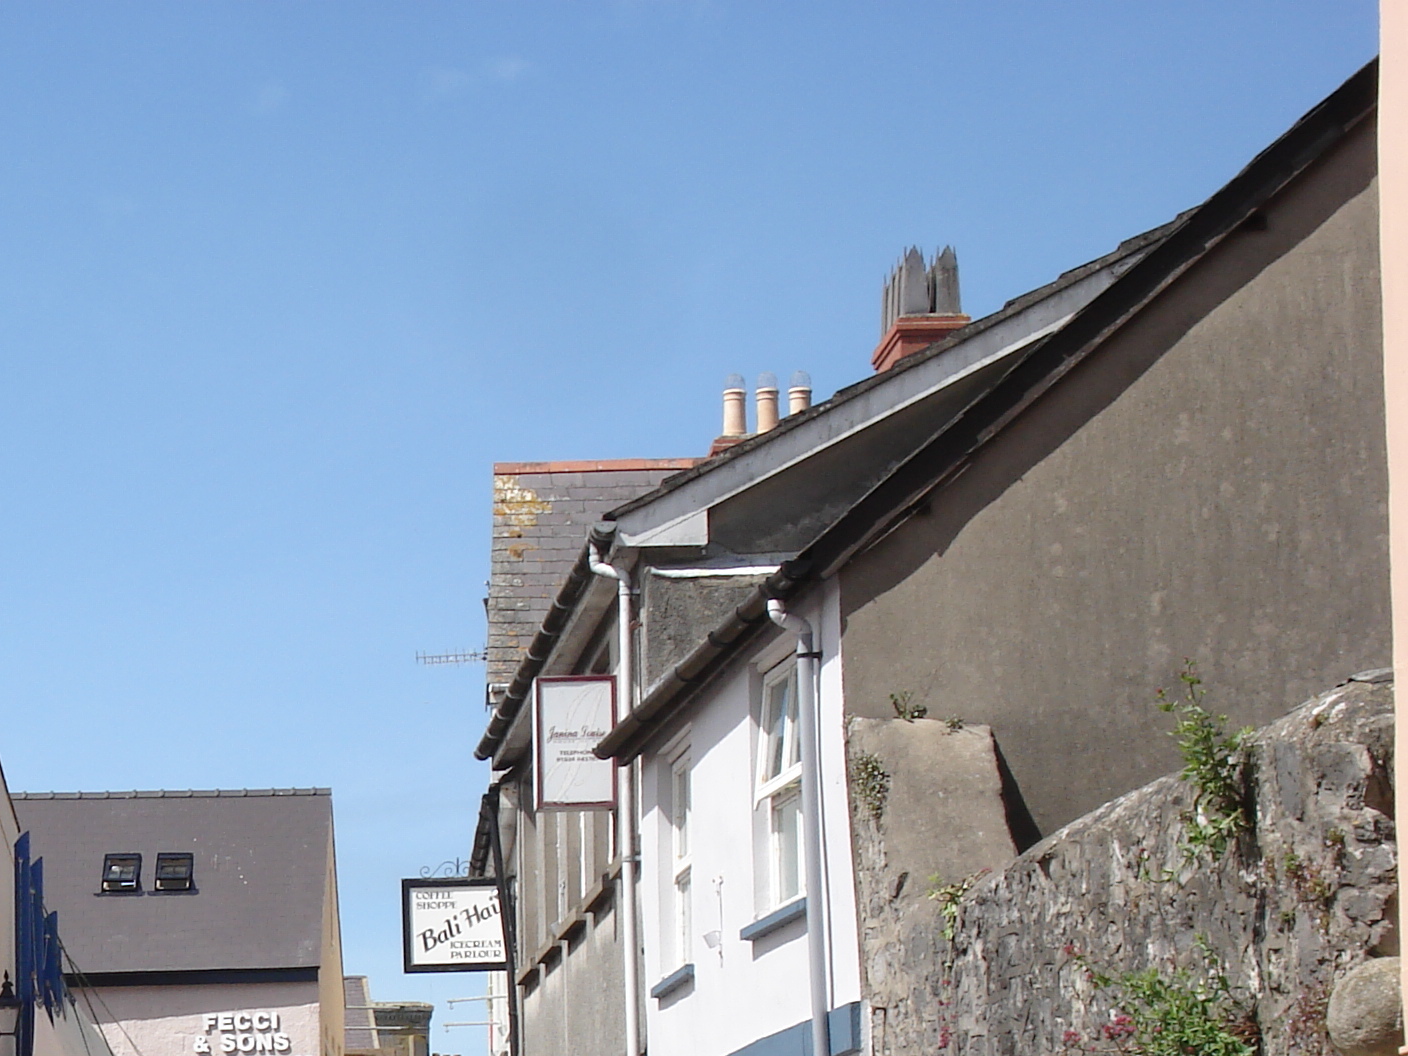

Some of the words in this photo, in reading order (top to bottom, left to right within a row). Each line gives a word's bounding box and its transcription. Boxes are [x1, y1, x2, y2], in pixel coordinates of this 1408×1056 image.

[417, 915, 462, 953] Bali
[460, 895, 501, 928] Hai
[450, 949, 501, 959] PARLOUR
[202, 1012, 279, 1032] FECCI
[193, 1036, 211, 1054] &
[220, 1032, 290, 1053] SONS
